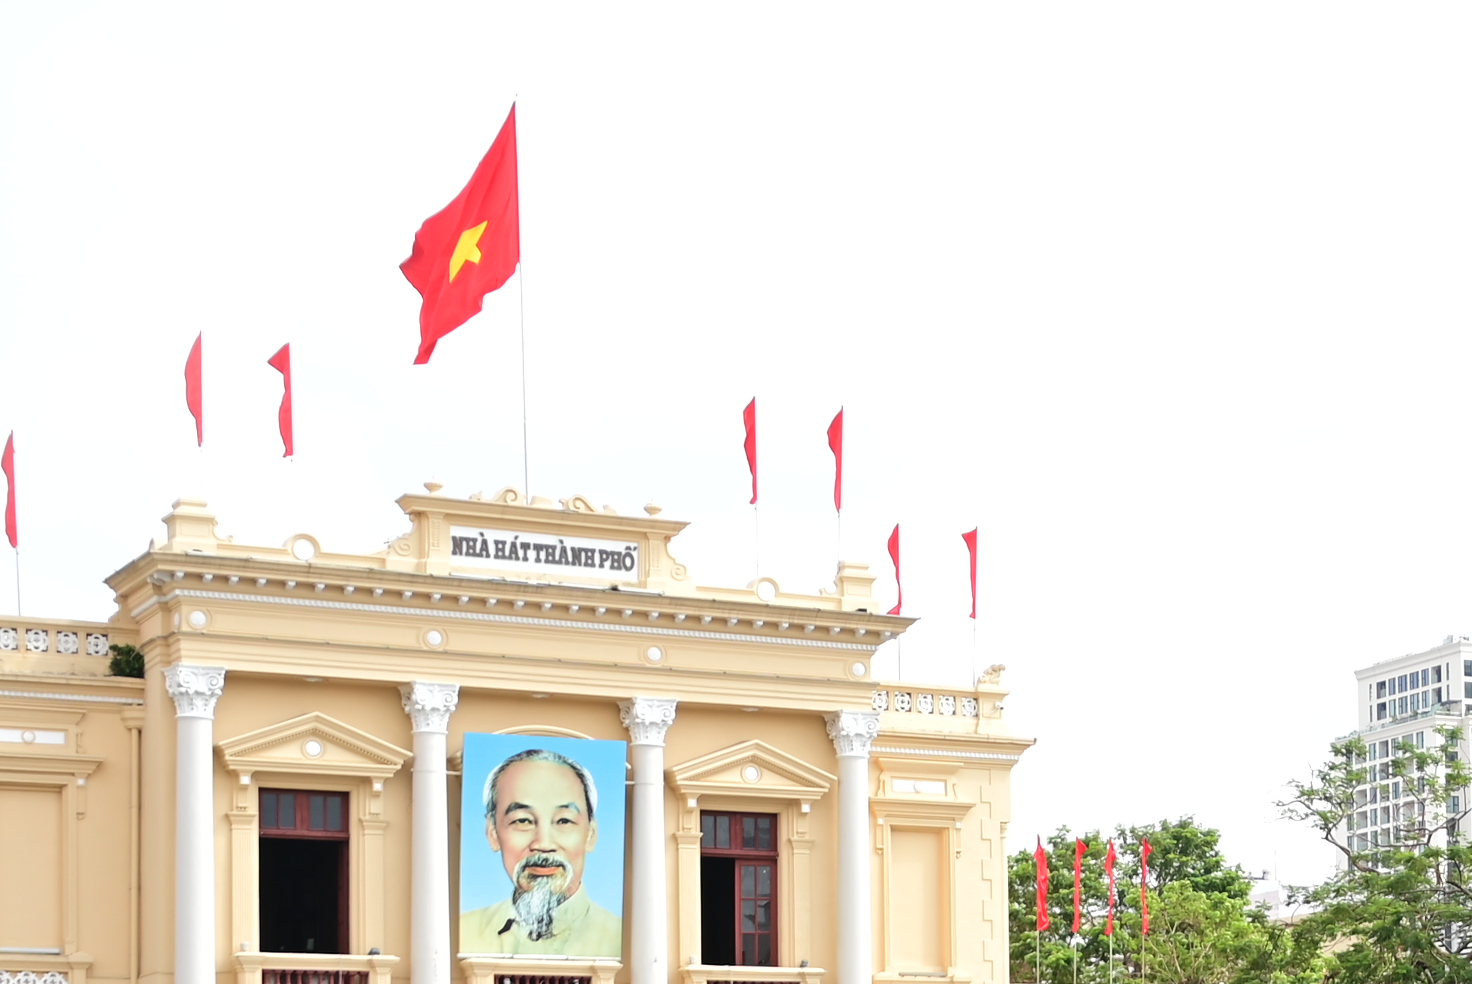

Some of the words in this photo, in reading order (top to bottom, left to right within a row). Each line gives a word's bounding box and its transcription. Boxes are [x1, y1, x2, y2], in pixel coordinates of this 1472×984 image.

[451, 532, 491, 559] NHÀ
[493, 535, 531, 562] HÁT
[532, 539, 597, 569] THÀNH
[598, 545, 638, 572] PHỐ
